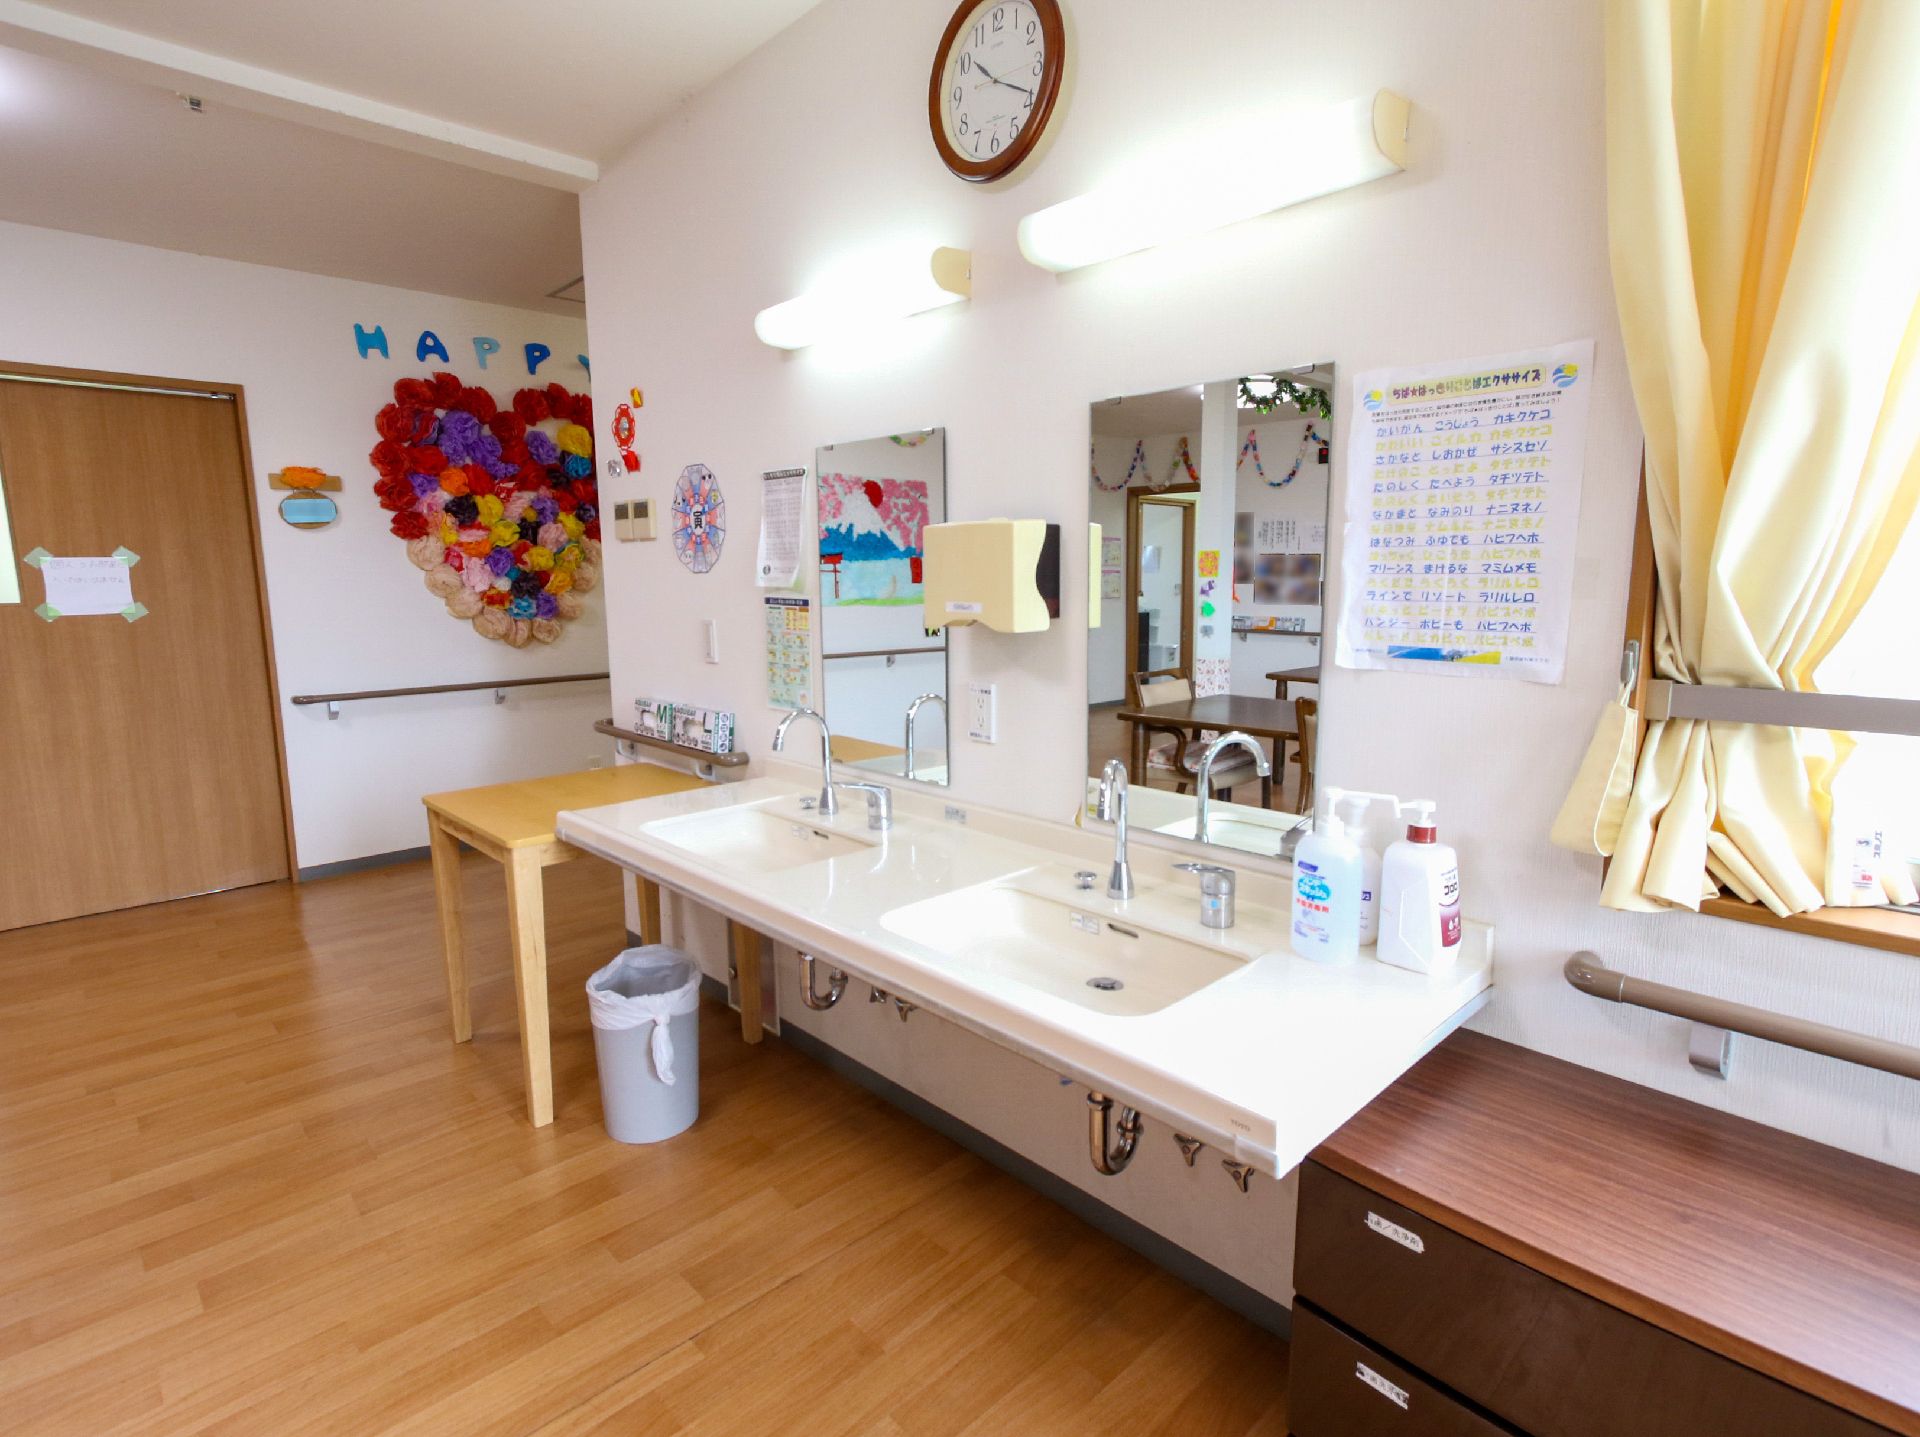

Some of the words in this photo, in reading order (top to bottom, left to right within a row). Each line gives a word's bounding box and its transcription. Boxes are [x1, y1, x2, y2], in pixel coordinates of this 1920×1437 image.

[992, 8, 1004, 32] 12
[975, 24, 984, 48] 11
[1026, 21, 1036, 45] 2
[960, 52, 971, 76] 10
[1032, 51, 1043, 77] 3
[953, 87, 962, 109] 9
[1023, 88, 1034, 111] 4
[959, 113, 969, 135] 8
[1009, 116, 1019, 140] 5
[974, 130, 981, 152] 7
[990, 131, 1000, 153] 6
[1494, 409, 1550, 425] カキクケコ
[1376, 452, 1421, 465] さかなと
[1491, 440, 1547, 455] サシスセソ
[1490, 471, 1544, 486] タチツテト
[1428, 505, 1473, 517] なみのり
[1486, 502, 1542, 515] ナニヌネノ
[1424, 564, 1468, 573] まけるな
[1482, 563, 1537, 574] マミムメモ
[1480, 592, 1535, 603] ラリルレロ
[656, 704, 667, 723] M
[704, 712, 712, 733] L
